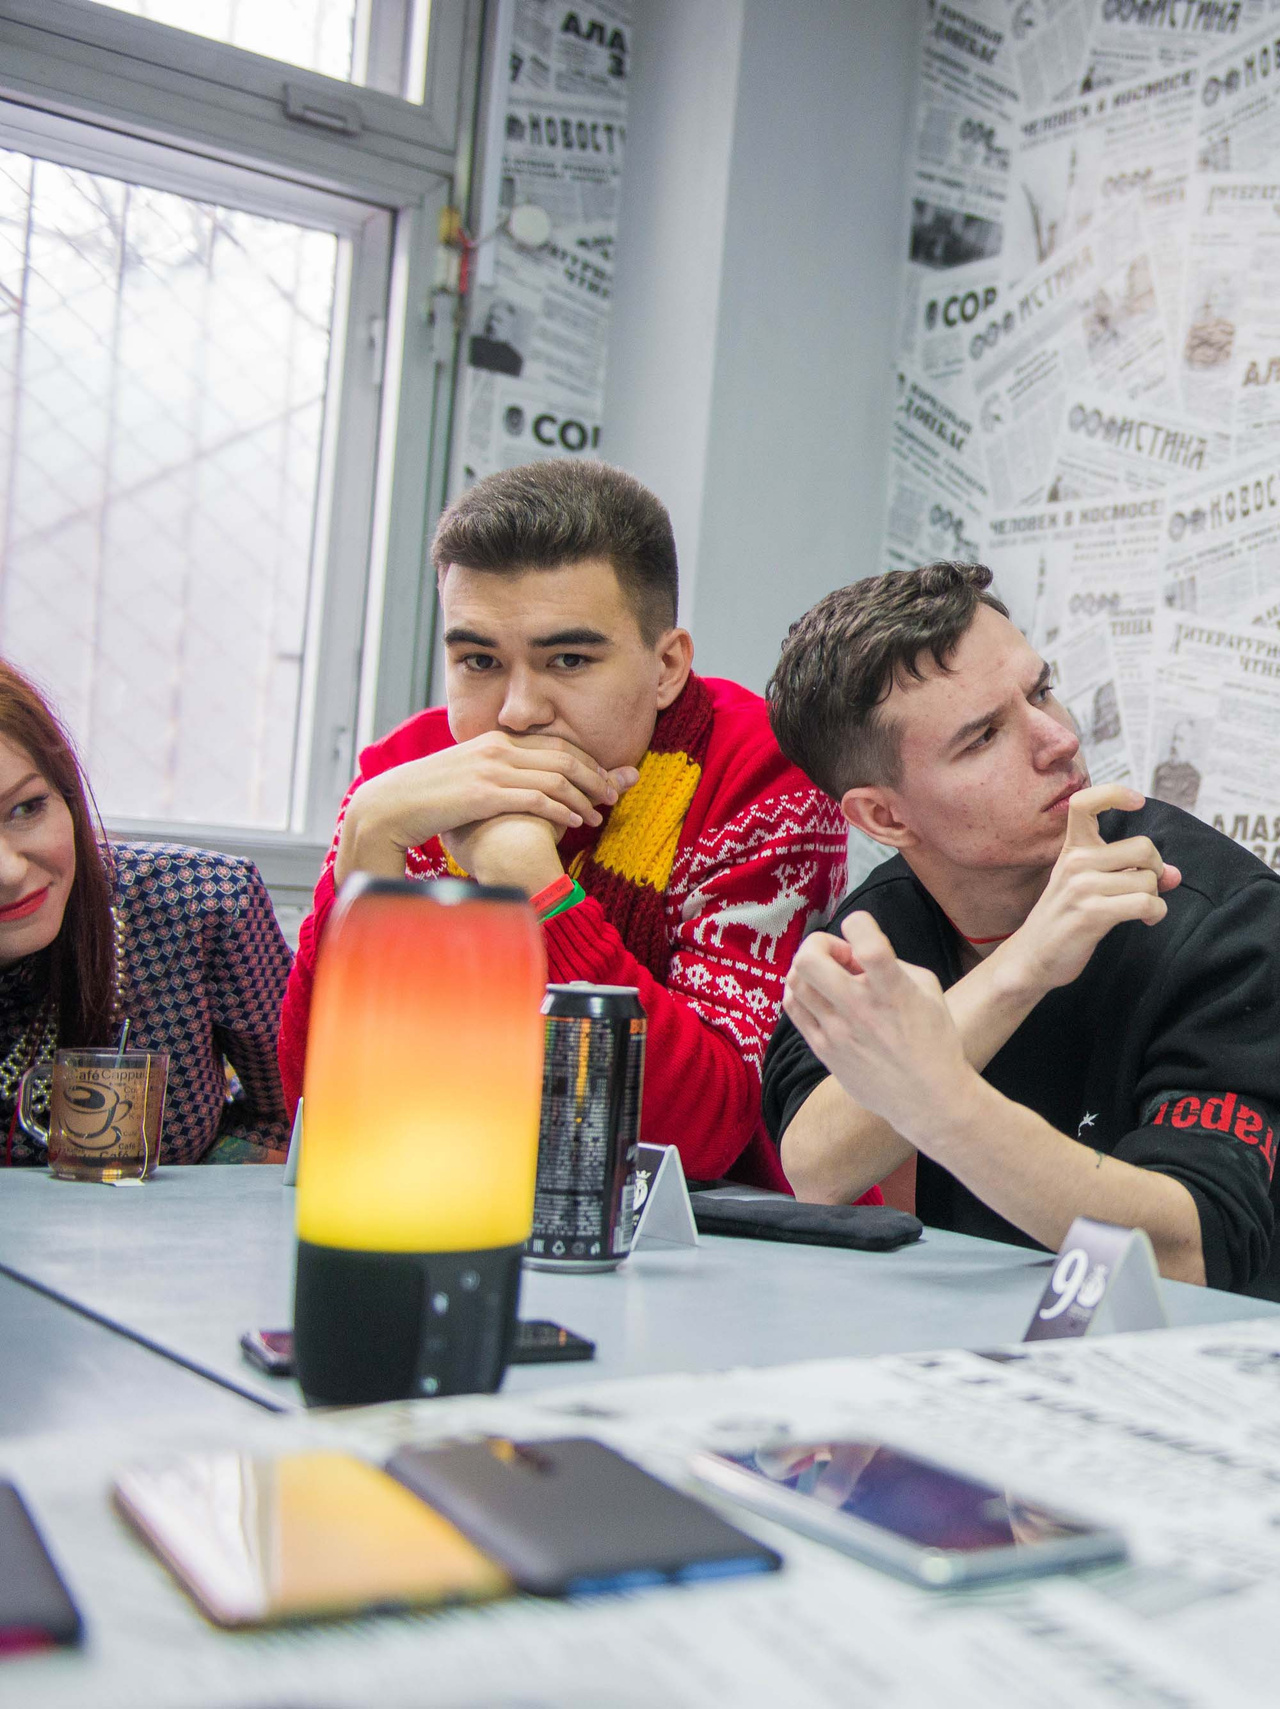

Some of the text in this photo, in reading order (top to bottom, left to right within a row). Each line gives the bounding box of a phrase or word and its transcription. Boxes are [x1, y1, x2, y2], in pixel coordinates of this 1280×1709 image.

[989, 511, 1057, 536] ЧЕЛОВЕК
[1064, 510, 1074, 527] В
[1039, 1248, 1089, 1320] 9
